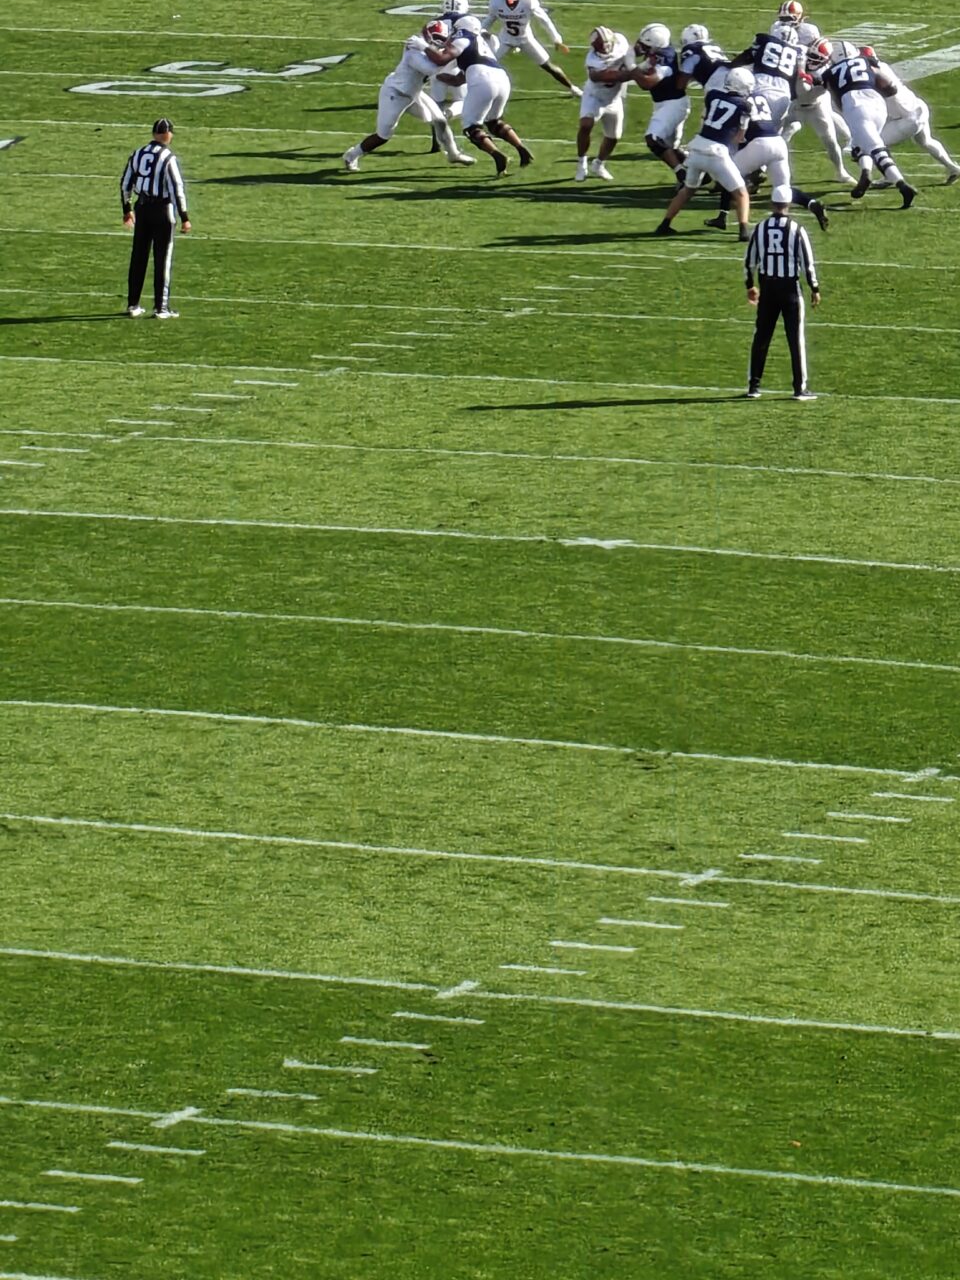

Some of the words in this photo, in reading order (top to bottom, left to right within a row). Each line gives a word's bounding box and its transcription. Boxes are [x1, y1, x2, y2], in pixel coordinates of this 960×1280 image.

[505, 21, 520, 37] 5
[761, 42, 798, 76] 68
[831, 58, 869, 88] 72
[704, 98, 738, 130] 17
[138, 153, 154, 176] C
[767, 228, 784, 253] R
